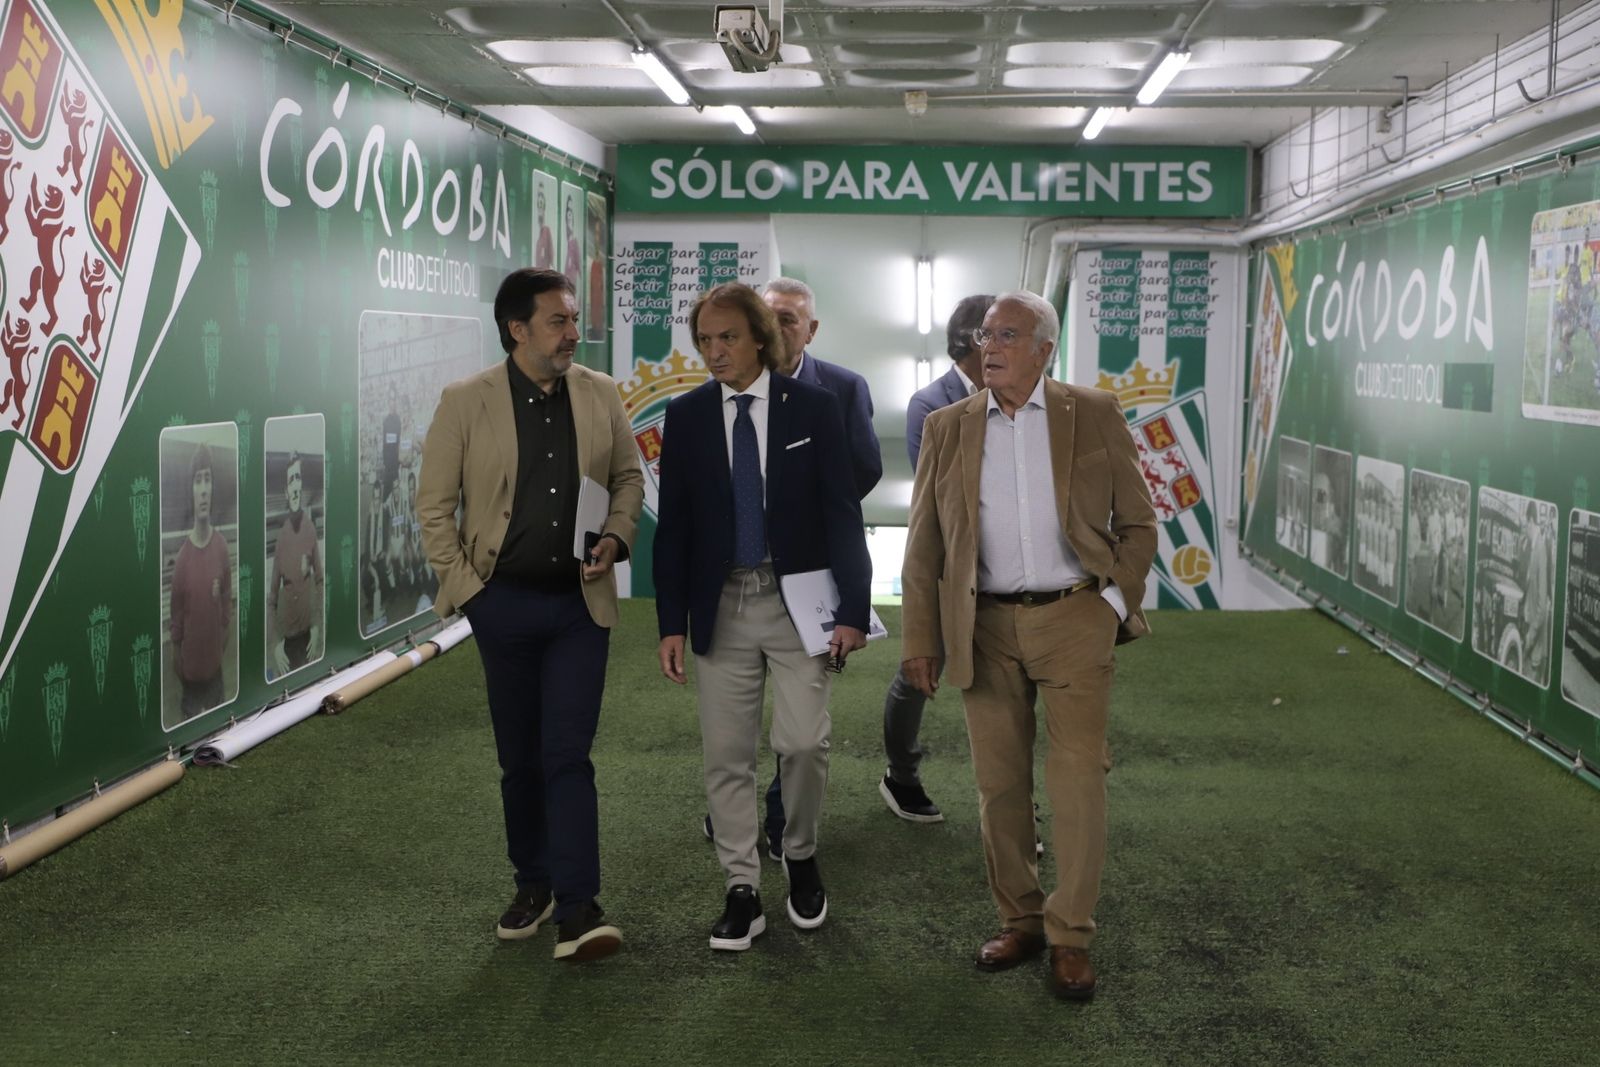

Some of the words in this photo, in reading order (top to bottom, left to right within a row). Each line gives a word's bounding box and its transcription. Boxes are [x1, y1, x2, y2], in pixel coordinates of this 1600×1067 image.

[260, 81, 511, 259] CÓRDOBA
[650, 147, 784, 200] SÓLO
[803, 160, 930, 200] PARA
[942, 160, 1213, 202] VALIENTES
[617, 247, 663, 262] Jugar
[668, 249, 705, 262] para
[711, 249, 758, 262] ganar
[616, 263, 666, 276] Ganar
[670, 265, 707, 279] para
[712, 264, 759, 276] sentir
[1089, 257, 1133, 273] Jugar
[1135, 259, 1169, 273] para
[1173, 259, 1218, 274] ganar
[614, 279, 663, 292] Sentir
[667, 282, 705, 296] para
[1088, 273, 1134, 286] Ganar
[1137, 275, 1171, 290] para
[1176, 273, 1219, 287] sentir
[618, 296, 672, 308] Luchar
[1085, 289, 1132, 303] Sentir
[1134, 293, 1168, 307] para
[1173, 289, 1220, 304] luchar
[1305, 235, 1494, 352] CÓRDOBA
[622, 312, 661, 325] Vivir
[664, 315, 690, 329] par
[1089, 307, 1140, 320] Luchar
[1144, 309, 1178, 322] para
[1182, 307, 1215, 320] vivir
[1093, 322, 1129, 336] Vivir
[1130, 325, 1165, 341] para
[1169, 323, 1211, 338] soñar
